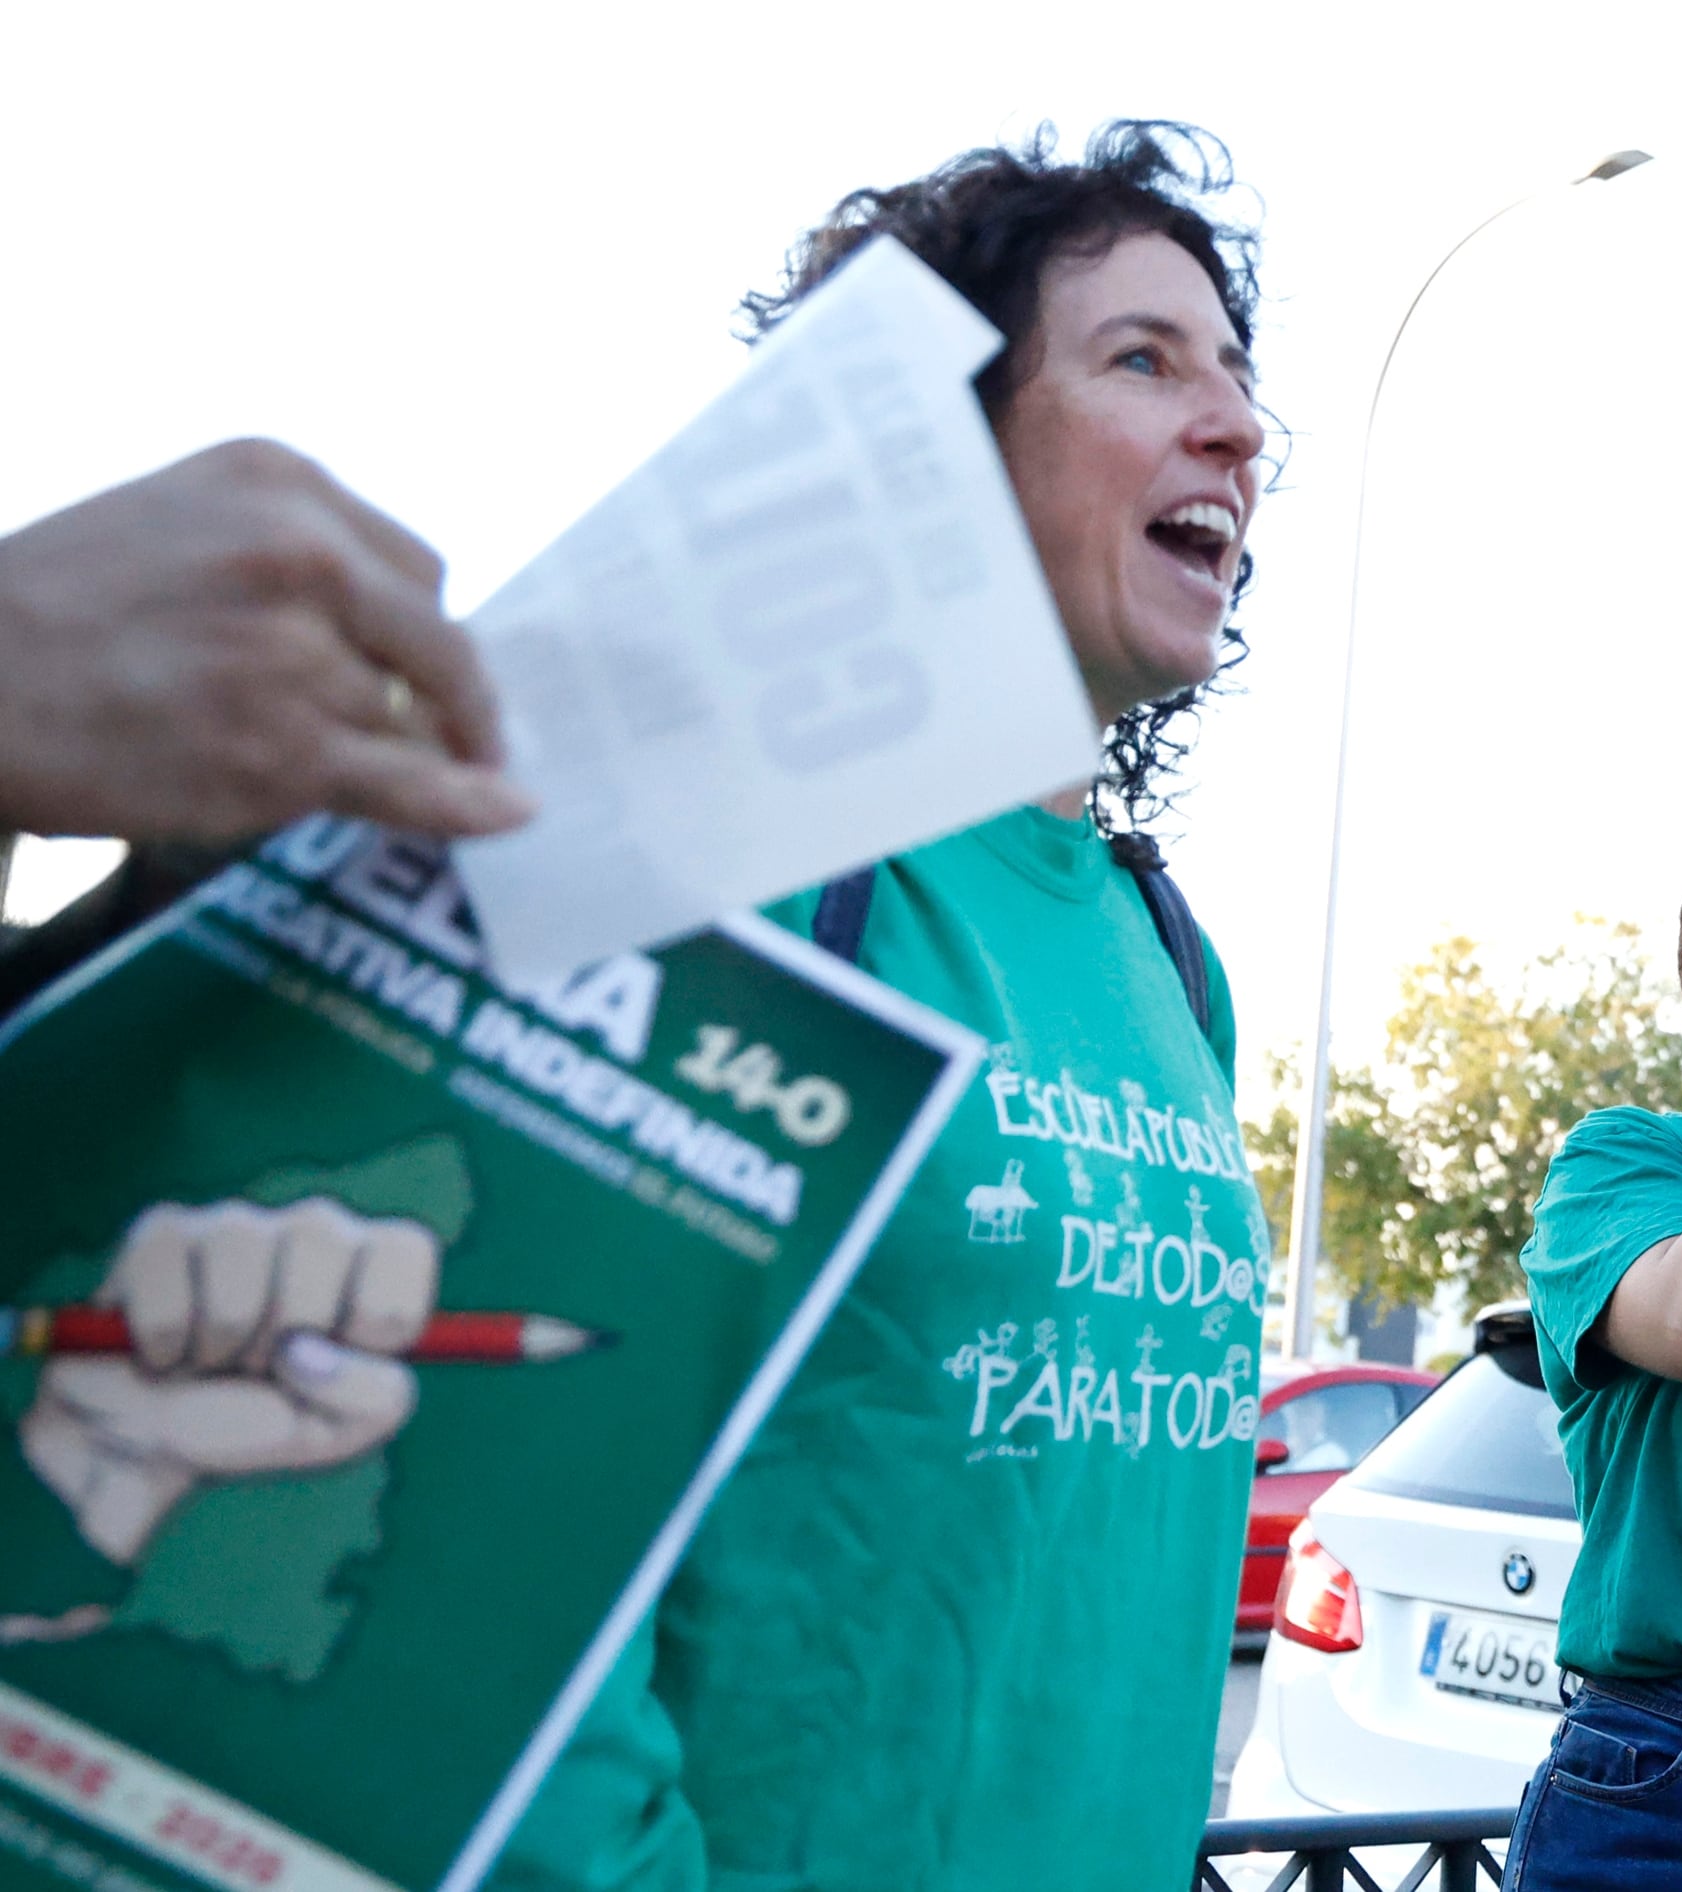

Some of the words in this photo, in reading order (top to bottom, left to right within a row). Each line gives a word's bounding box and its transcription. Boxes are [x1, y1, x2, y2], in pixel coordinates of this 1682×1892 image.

[460, 1000, 804, 1226] INDEFINIDA
[1056, 1214, 1133, 1296] DE
[969, 1354, 1122, 1445] PARA
[1451, 1626, 1549, 1688] 4056
